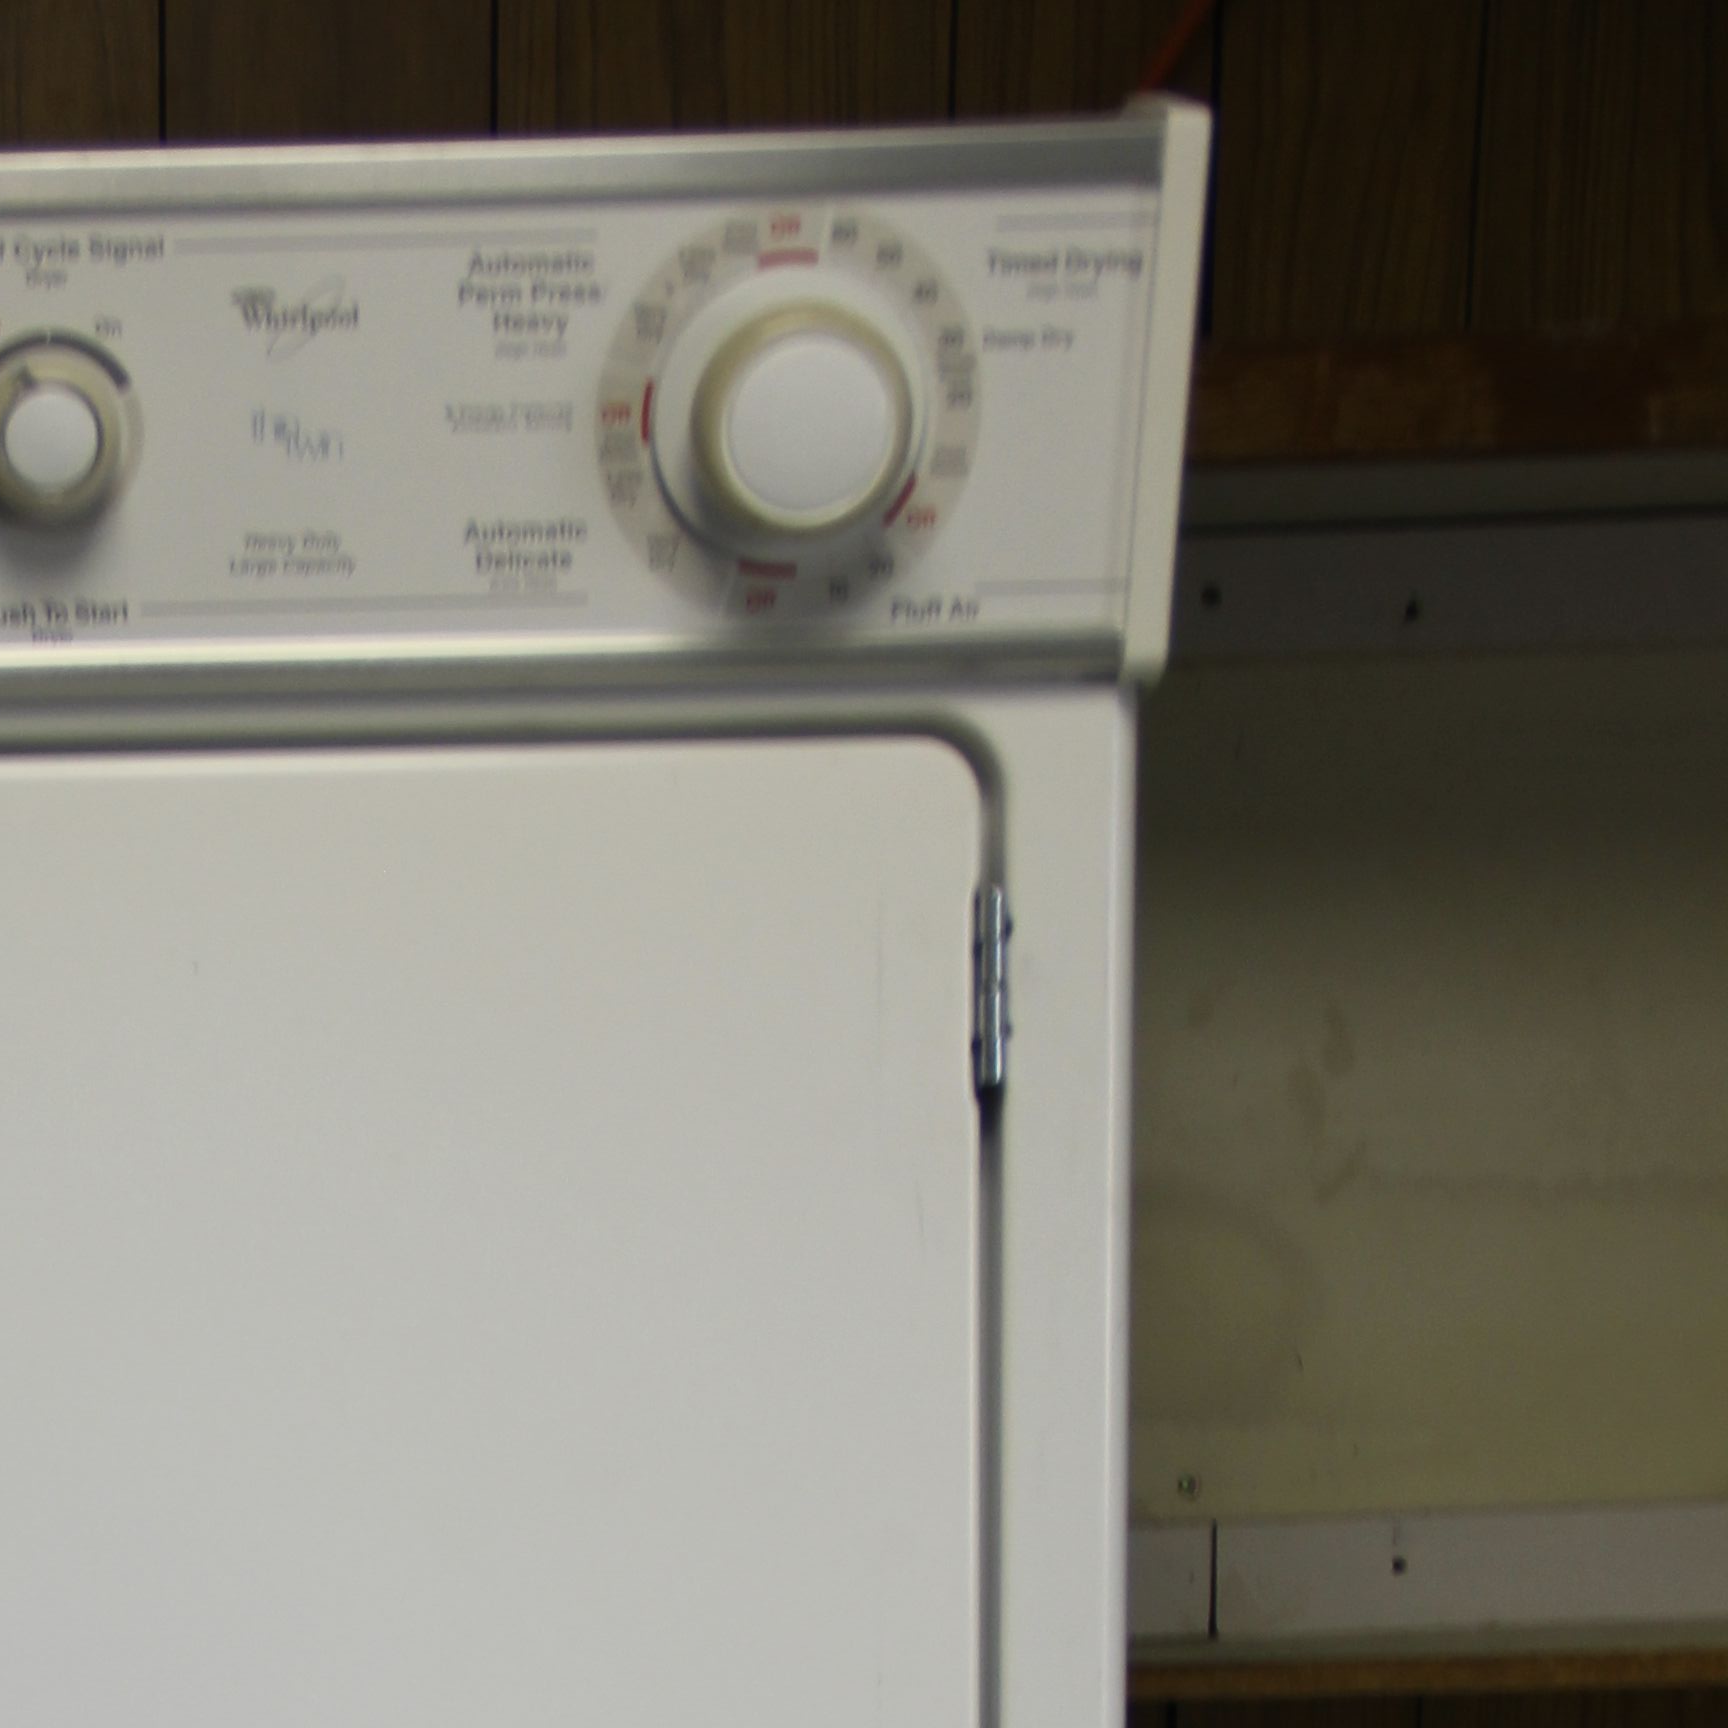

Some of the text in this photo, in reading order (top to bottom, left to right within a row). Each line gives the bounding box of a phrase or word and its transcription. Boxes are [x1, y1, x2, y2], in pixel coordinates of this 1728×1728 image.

[14, 235, 80, 268] Cycle
[89, 233, 164, 265] Signal
[468, 247, 594, 276] Automatic
[1065, 246, 1144, 282] Drying
[457, 275, 604, 308] Perm Press
[240, 290, 359, 336] Whirlpool
[491, 308, 566, 340] Heavy
[243, 528, 342, 557] Heavy Duty
[464, 519, 588, 547] Automatic
[228, 552, 356, 582] Large Capacity
[474, 548, 573, 576] Delicate
[42, 596, 69, 626] To
[74, 596, 128, 627] Start
[890, 593, 982, 624] Fluff Air
